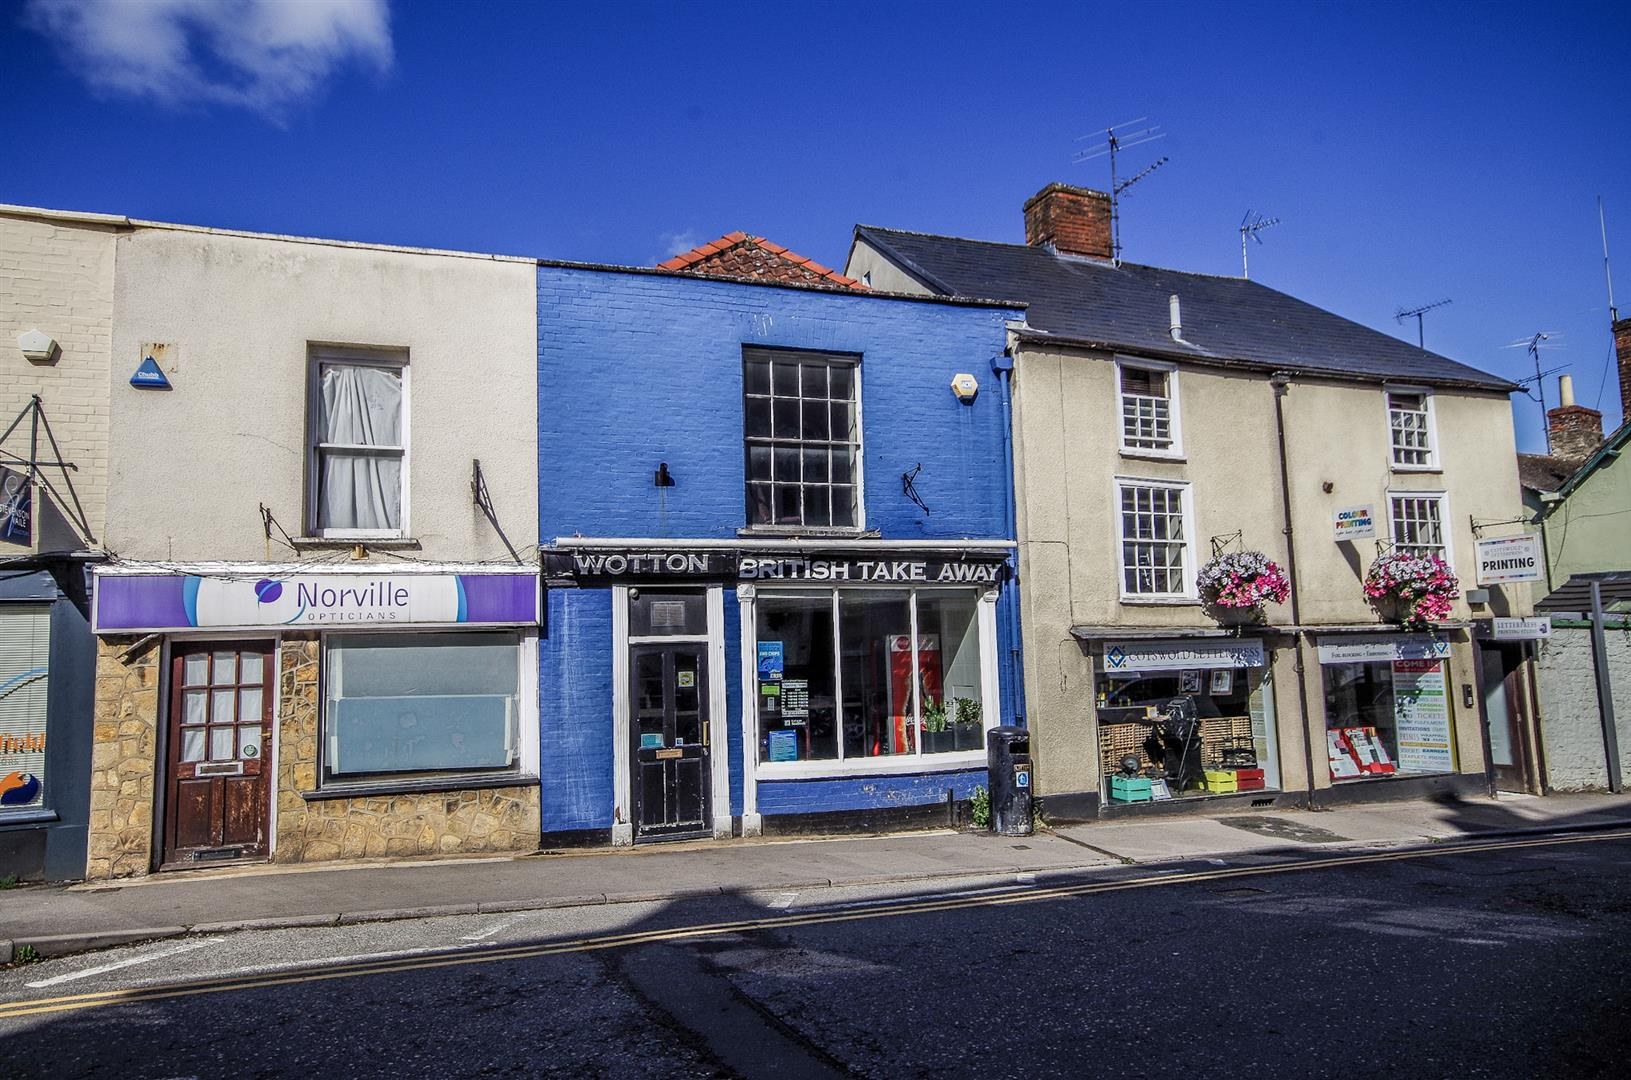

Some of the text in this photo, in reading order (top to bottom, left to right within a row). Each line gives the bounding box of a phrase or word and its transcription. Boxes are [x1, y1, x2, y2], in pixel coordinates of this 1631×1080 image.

[1338, 509, 1368, 520] COLOUR
[1336, 518, 1372, 529] PRINTING
[573, 553, 1001, 582] WOTTON BRITISH TAKE AWAY
[1482, 557, 1535, 571] PRINTING
[297, 581, 409, 608] Norville
[308, 612, 396, 621] OPTICIANS
[1128, 647, 1260, 662] COTSWOLD LETTERPRESS
[1395, 660, 1425, 668] COME
